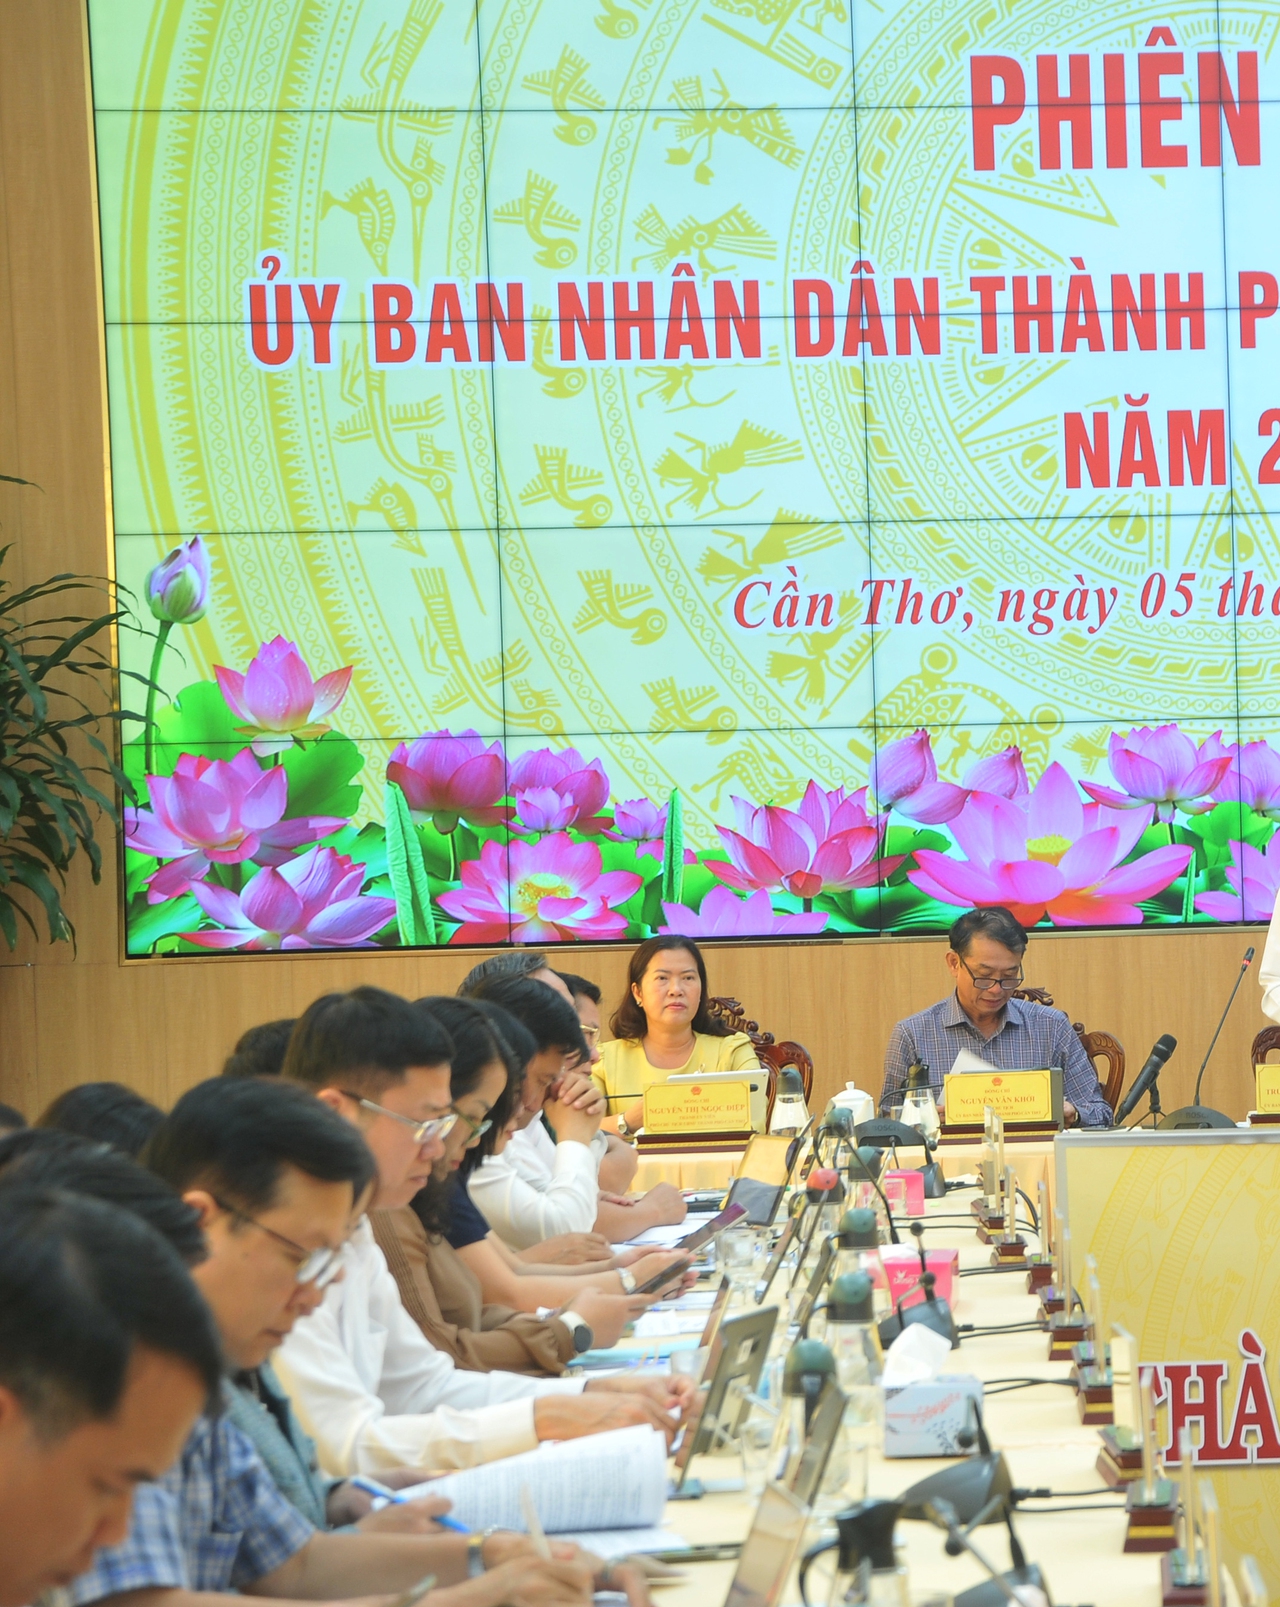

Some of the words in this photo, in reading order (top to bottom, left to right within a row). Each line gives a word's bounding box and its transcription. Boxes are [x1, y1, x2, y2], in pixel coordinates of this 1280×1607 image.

[972, 27, 1262, 171] PHIÊN
[250, 256, 341, 366] ỦY
[373, 282, 527, 364] BAN
[558, 262, 762, 362] NHÂN
[794, 260, 942, 358] DÂN
[970, 256, 1206, 355] THÀNH
[1063, 393, 1227, 490] NĂM
[734, 565, 834, 629] Cần
[862, 578, 974, 635] Thơ,
[997, 574, 1119, 636] ngày
[1140, 572, 1197, 618] 05
[649, 1105, 683, 1115] NGUYỄN
[685, 1105, 699, 1114] THỊ
[700, 1104, 724, 1114] NGỌC
[960, 1096, 993, 1105] NGUYỄN
[995, 1094, 1013, 1104] VĂN
